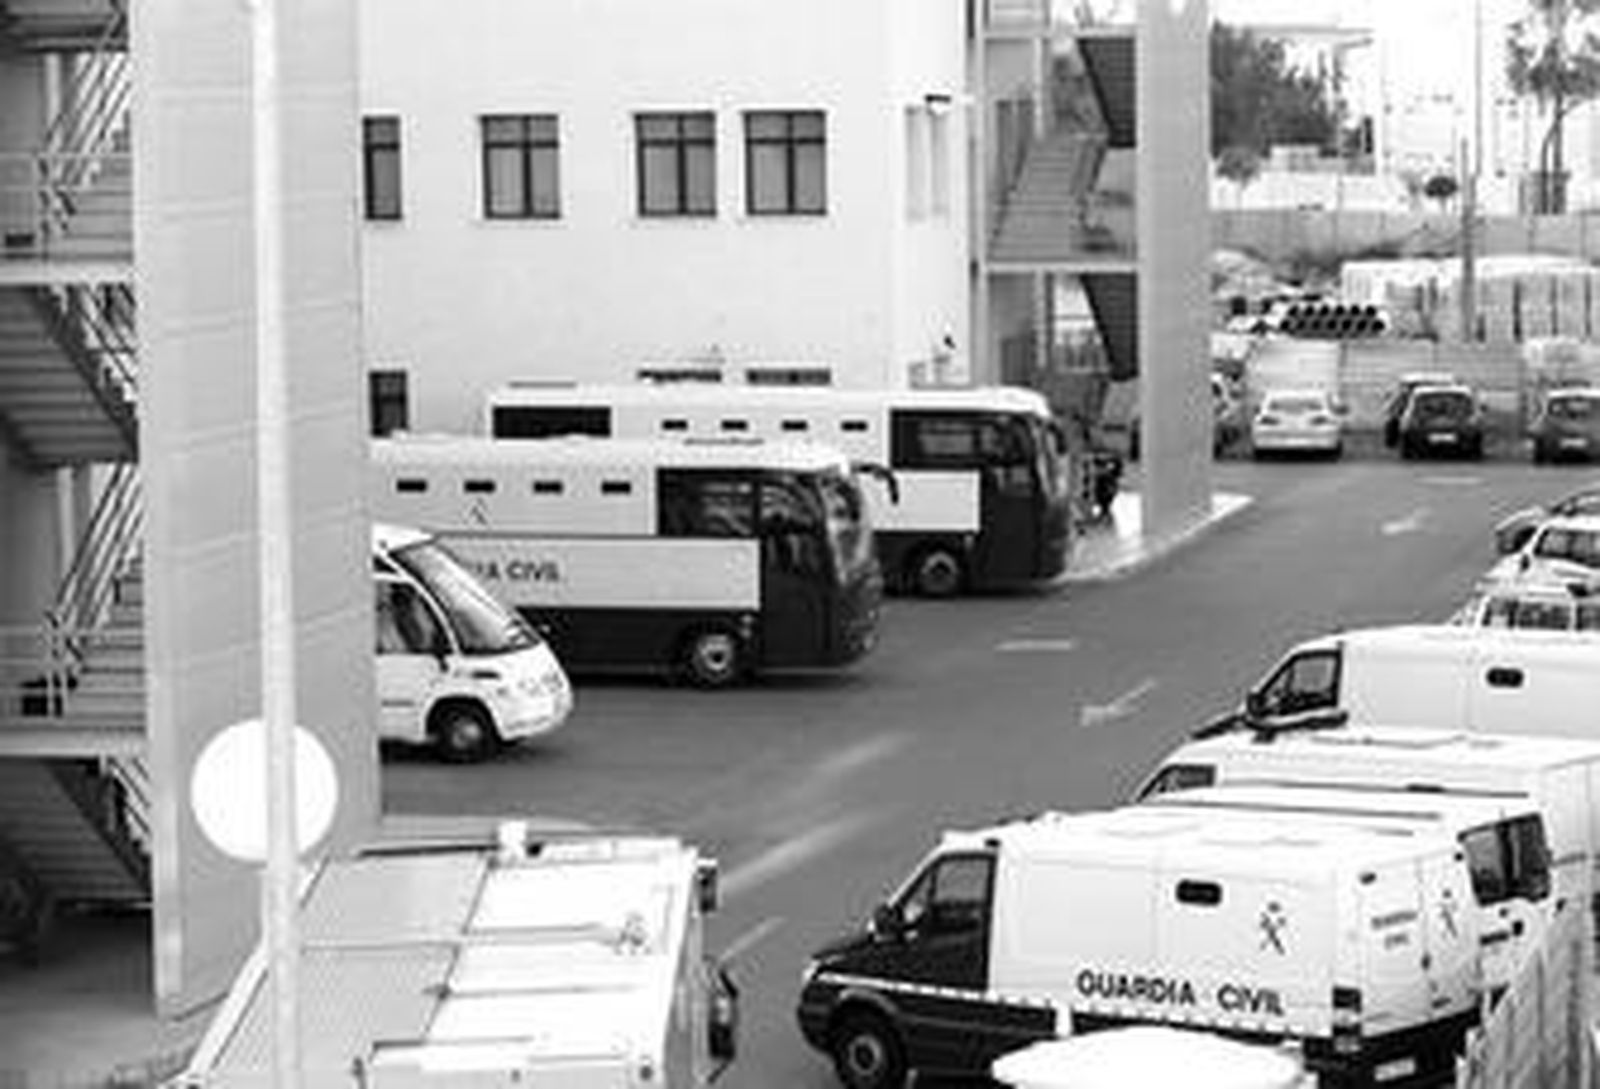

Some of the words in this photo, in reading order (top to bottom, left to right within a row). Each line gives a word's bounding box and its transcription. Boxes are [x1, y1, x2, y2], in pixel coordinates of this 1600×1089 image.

[506, 561, 560, 580] CIVIL
[1076, 968, 1197, 1006] GUARDIA
[1216, 983, 1285, 1018] CIVIL
